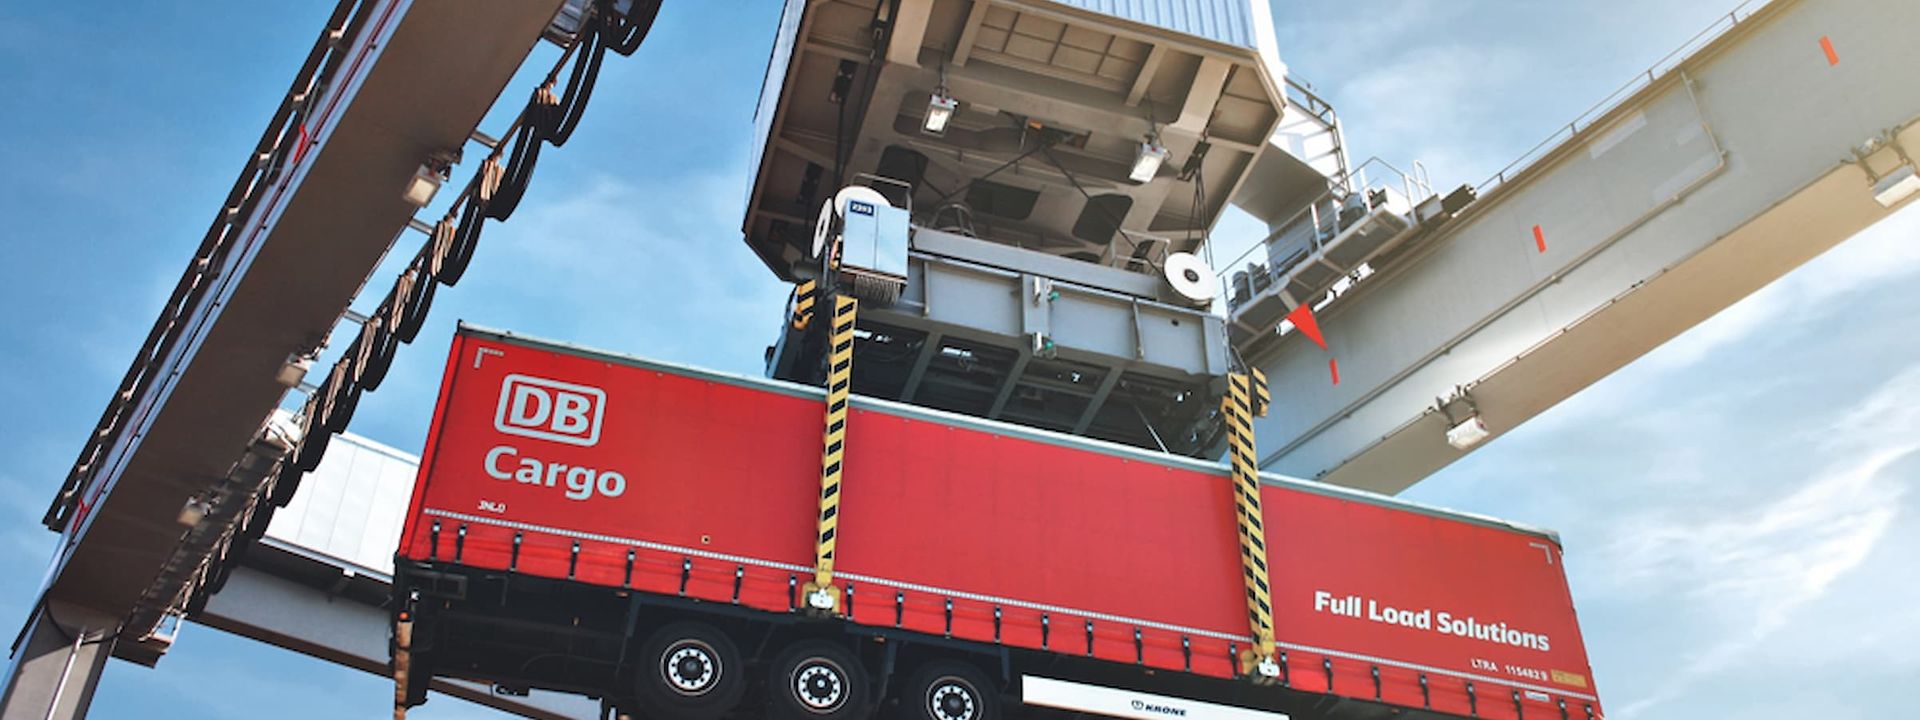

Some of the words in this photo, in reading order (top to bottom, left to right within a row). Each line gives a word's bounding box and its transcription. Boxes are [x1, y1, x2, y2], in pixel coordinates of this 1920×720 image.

[509, 385, 591, 434] DB
[484, 445, 627, 501] Cargo
[1314, 591, 1362, 618] Full
[1368, 600, 1431, 630] Load
[1436, 612, 1550, 651] Solutions
[1471, 658, 1498, 672] LTRA
[1145, 704, 1186, 716] KRONE
